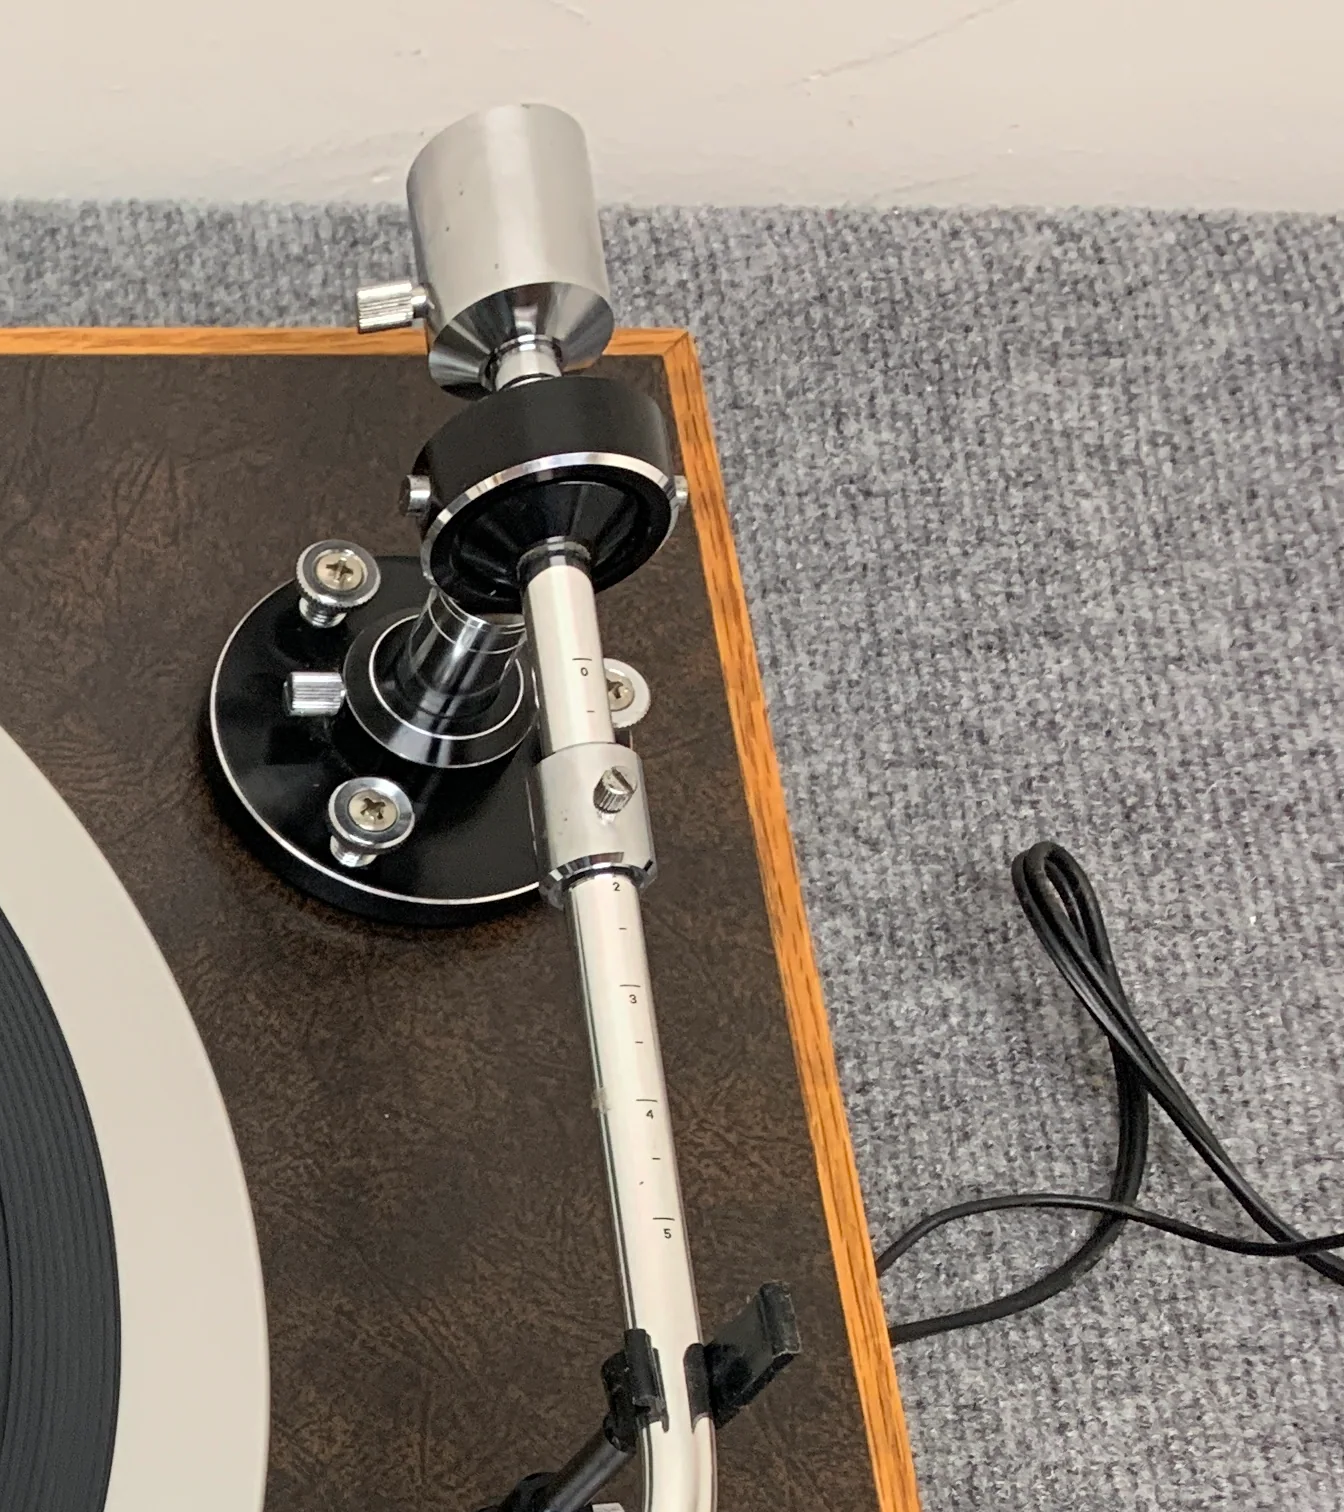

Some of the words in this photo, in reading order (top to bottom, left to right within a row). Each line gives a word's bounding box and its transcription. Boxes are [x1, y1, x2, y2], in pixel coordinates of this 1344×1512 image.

[581, 667, 589, 677] 0
[613, 881, 621, 892] 2
[628, 994, 637, 1004] 3
[645, 1109, 654, 1120] 4
[663, 1228, 672, 1239] 5
